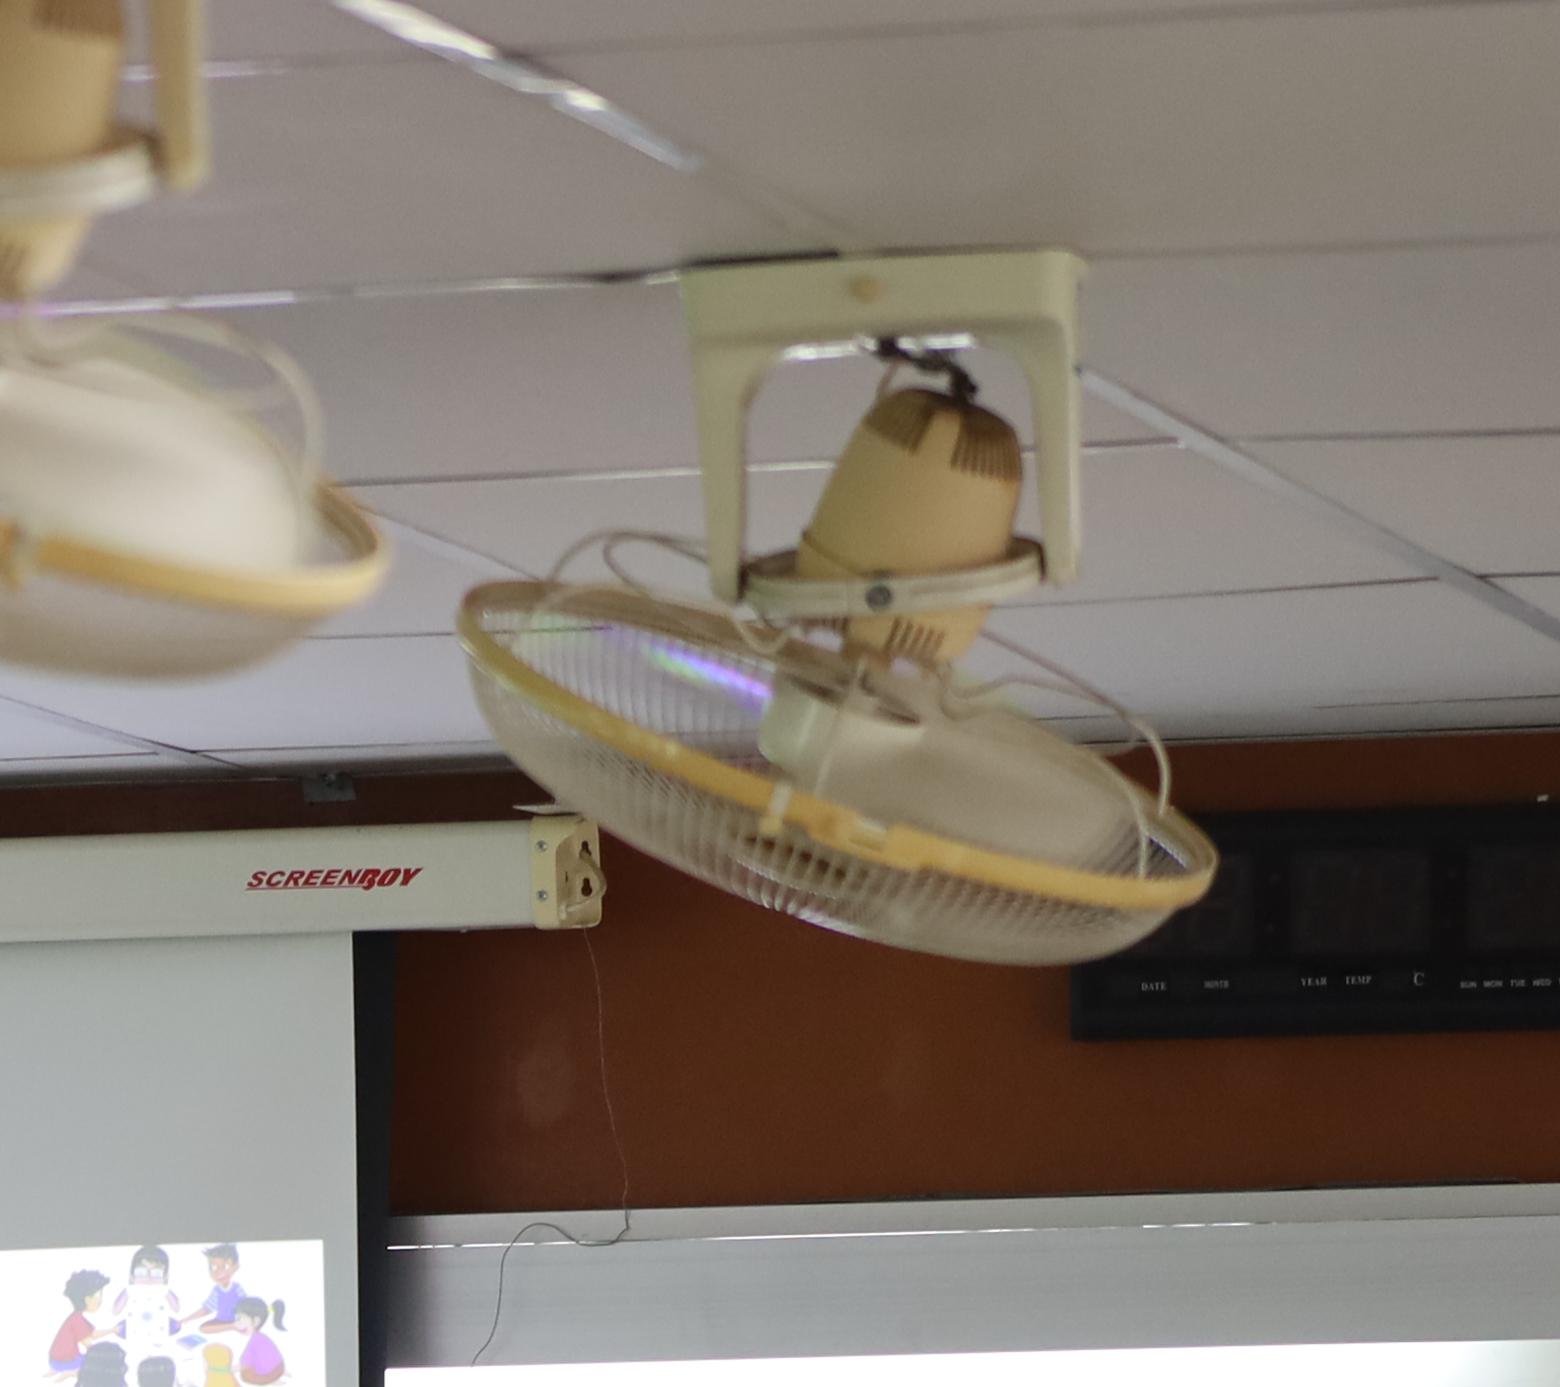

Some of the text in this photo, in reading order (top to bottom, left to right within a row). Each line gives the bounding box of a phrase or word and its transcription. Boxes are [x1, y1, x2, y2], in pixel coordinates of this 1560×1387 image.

[246, 867, 423, 892] SCREENBOY
[1140, 980, 1168, 992] DATE
[1300, 976, 1328, 987] YEAR
[1344, 974, 1372, 985] TEMP
[1482, 979, 1504, 988] MON
[1509, 978, 1527, 987] TUE
[1532, 978, 1553, 987] WED
